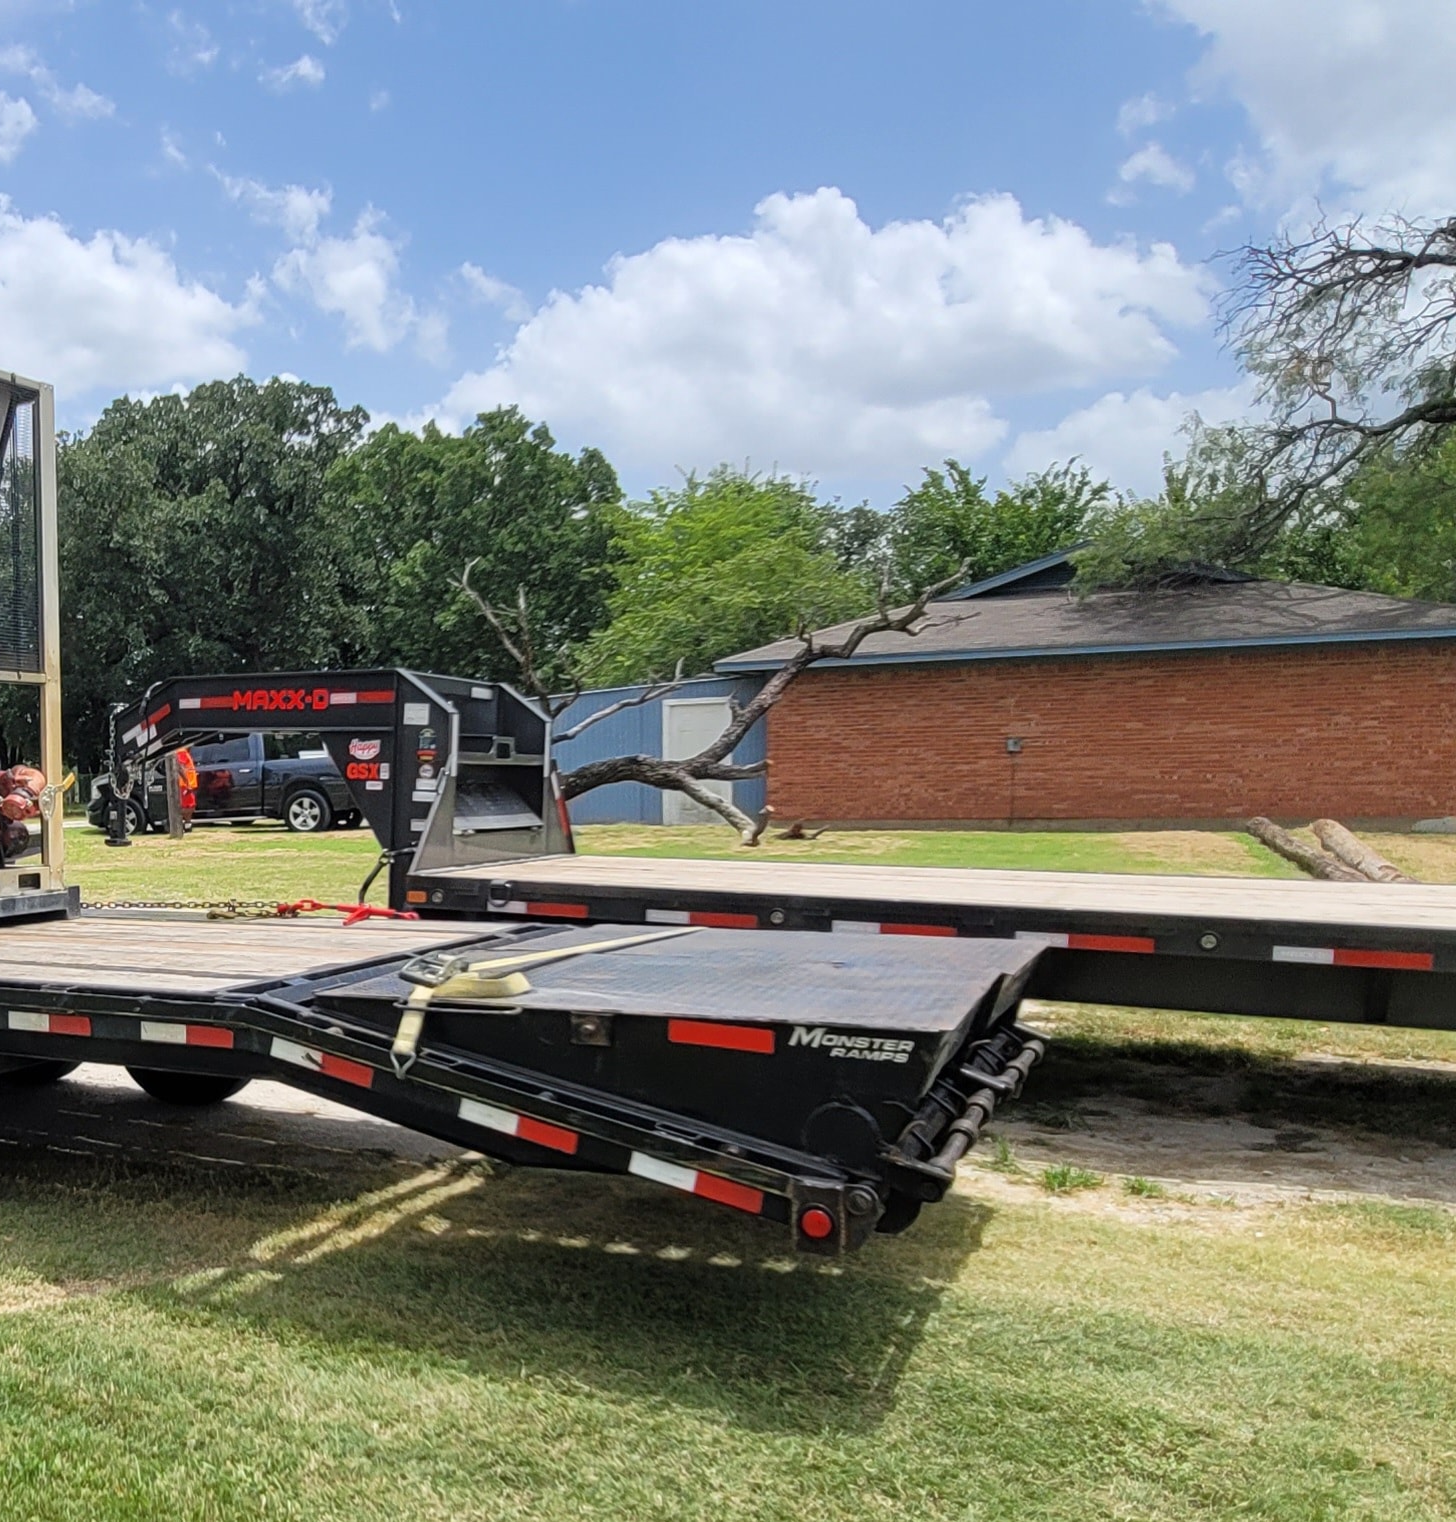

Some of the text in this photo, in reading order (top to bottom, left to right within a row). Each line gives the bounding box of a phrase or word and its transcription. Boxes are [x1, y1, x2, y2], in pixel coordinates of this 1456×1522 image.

[346, 762, 380, 779] GSX
[787, 1025, 915, 1052] MONSTER
[829, 1048, 910, 1063] RAMPS
